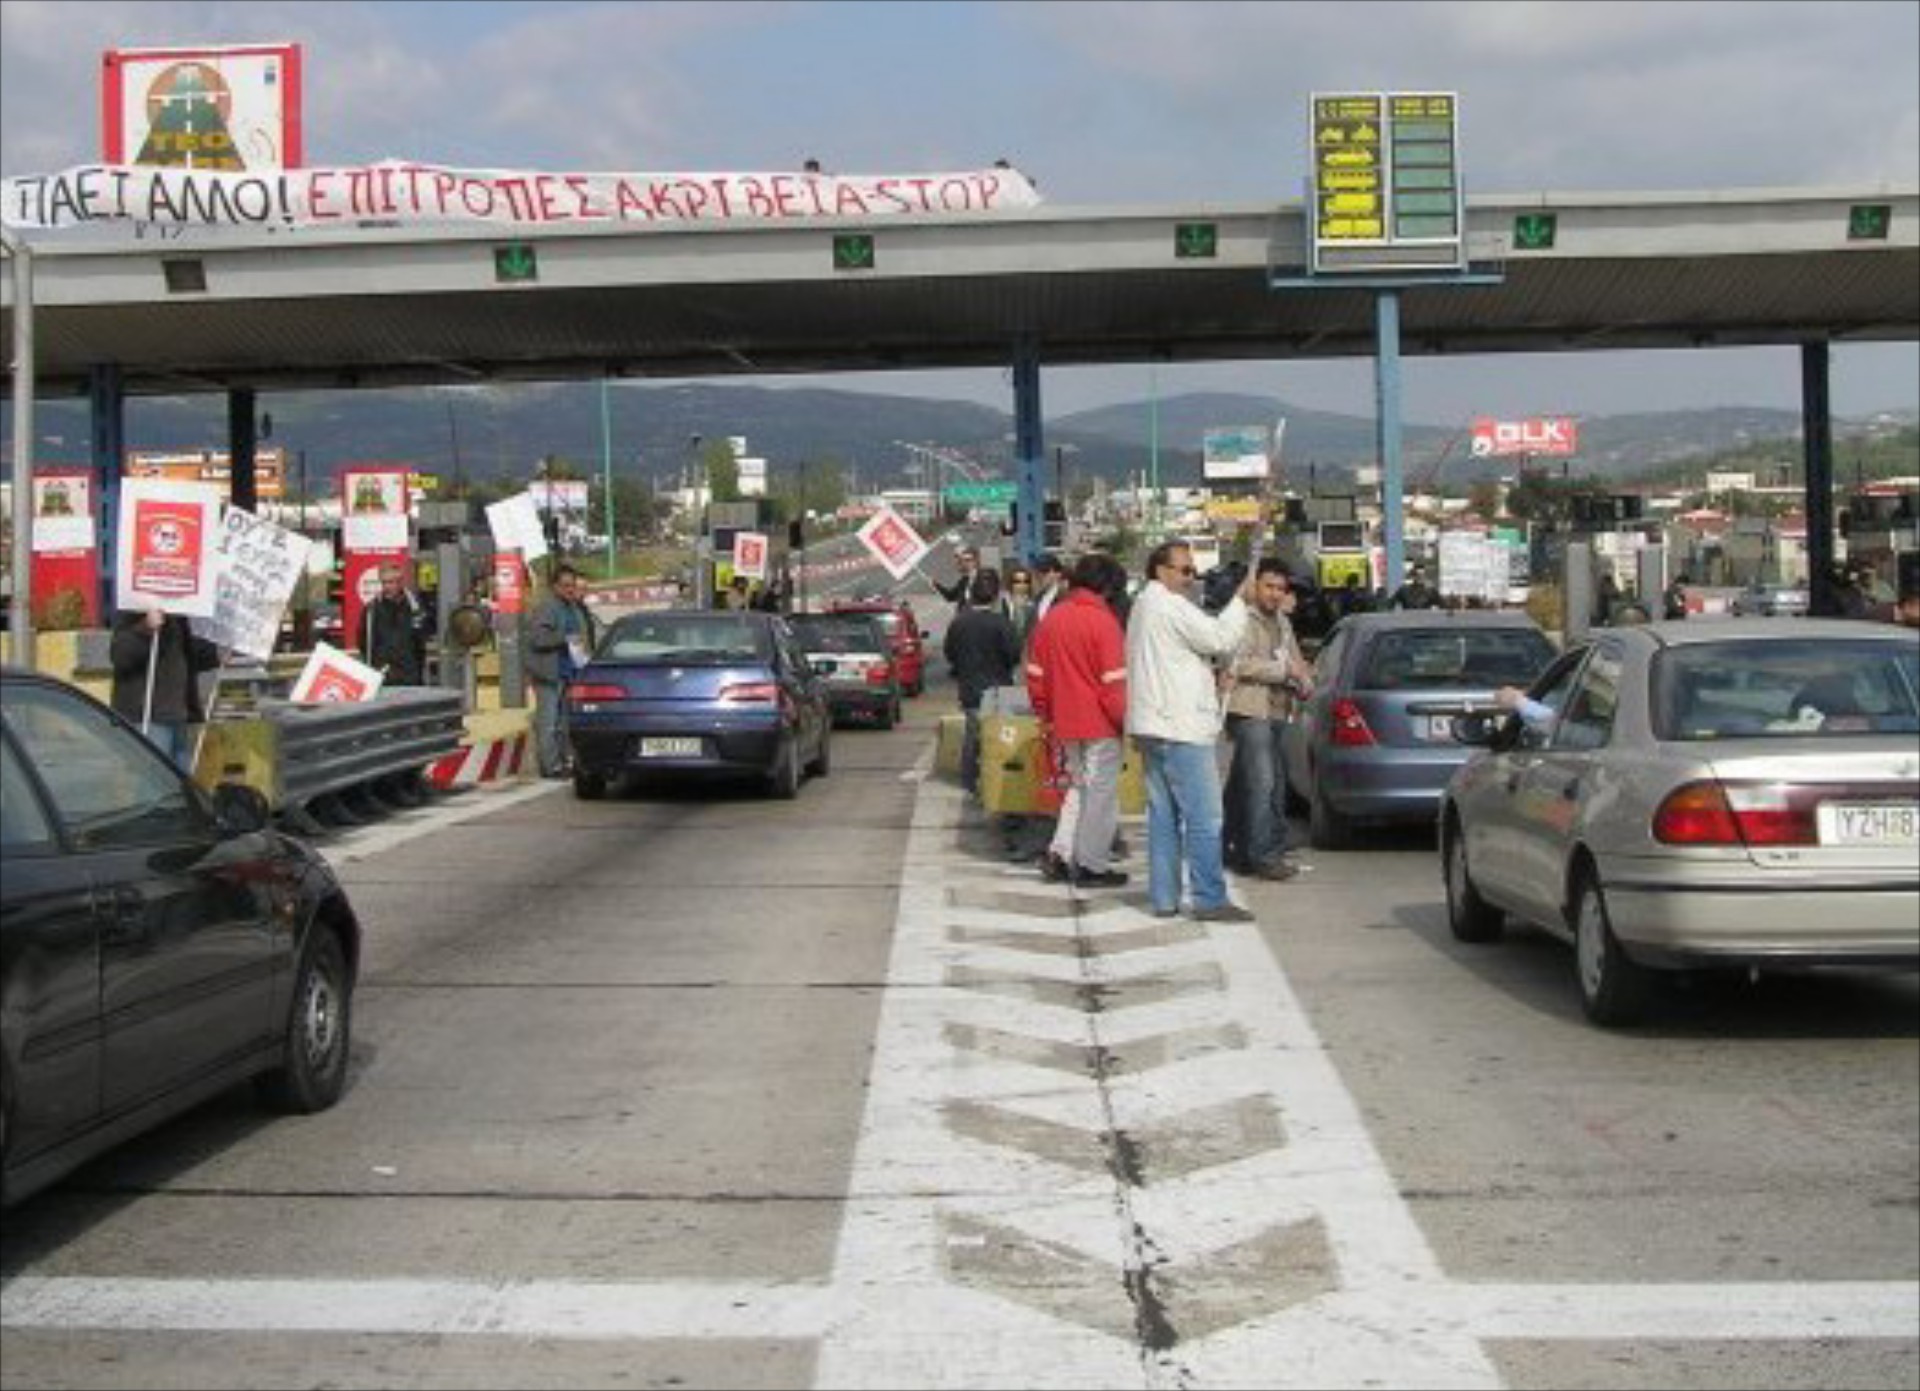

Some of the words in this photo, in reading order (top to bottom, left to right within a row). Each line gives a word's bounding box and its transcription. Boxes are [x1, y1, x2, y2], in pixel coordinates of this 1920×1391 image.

[15, 168, 132, 224] ΠΑΕΙ
[148, 172, 294, 224] ΑΛΛΟ!
[308, 168, 608, 220] ΕΠΙΤΡΟΠΕΣ
